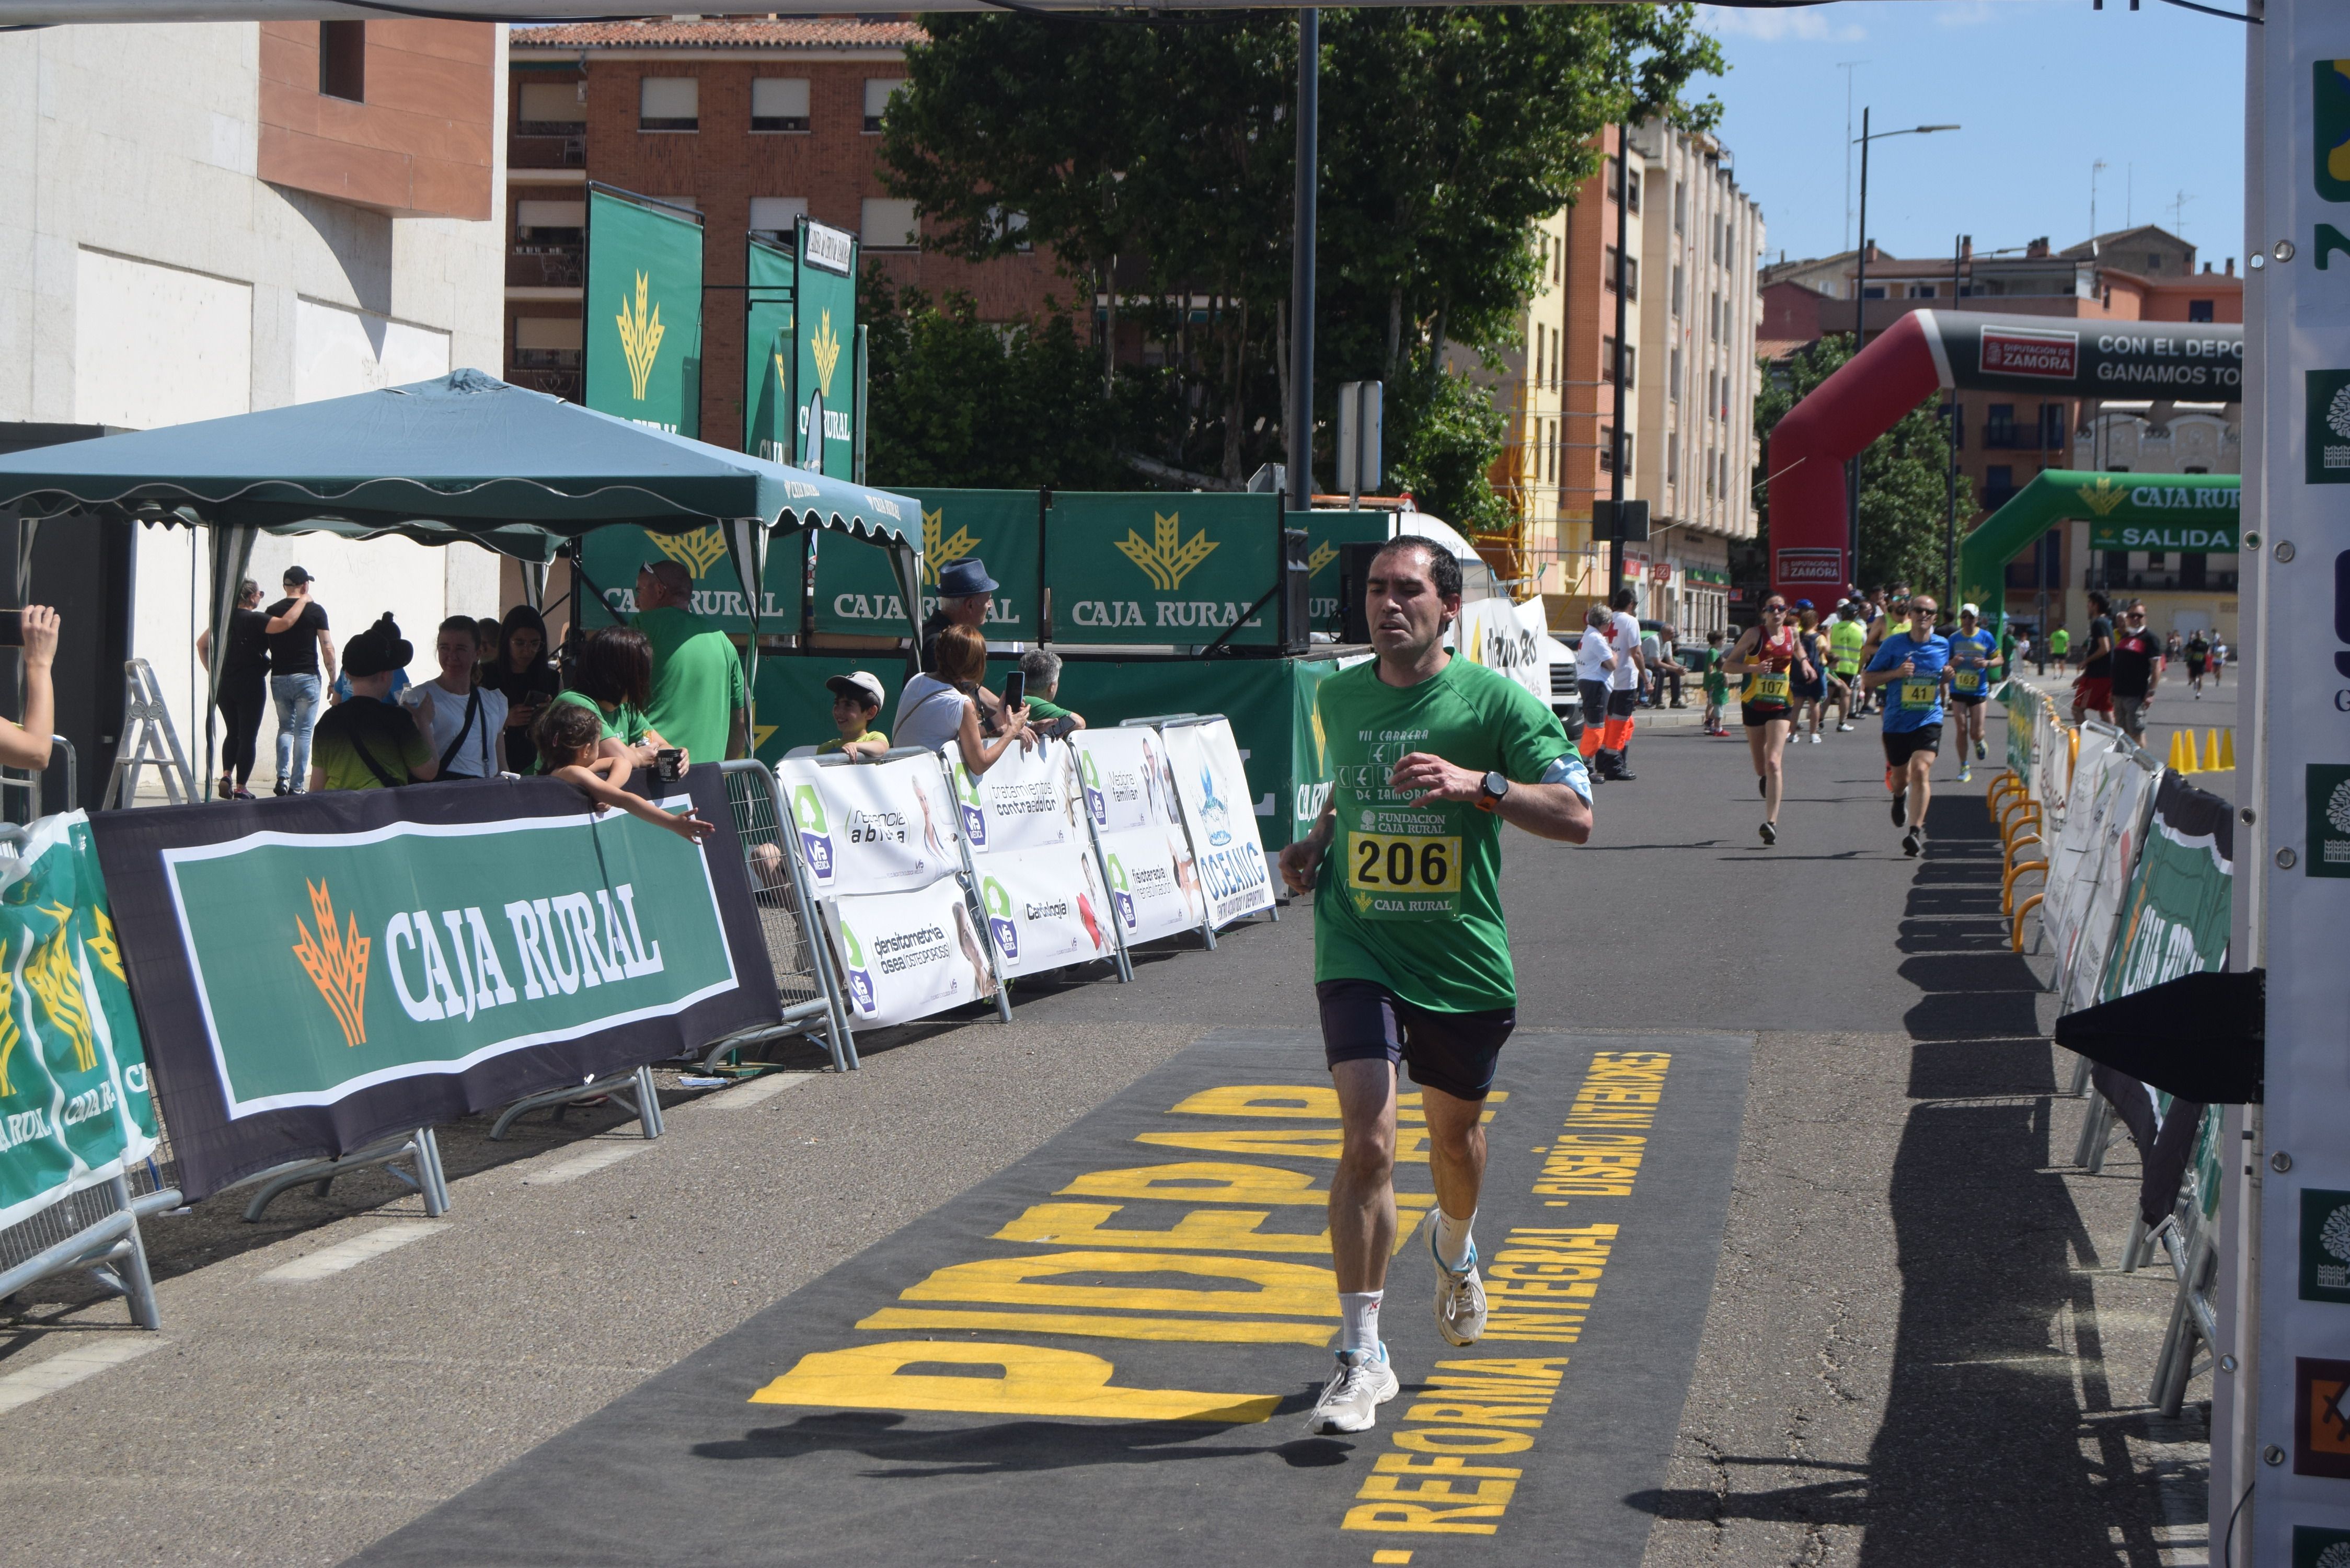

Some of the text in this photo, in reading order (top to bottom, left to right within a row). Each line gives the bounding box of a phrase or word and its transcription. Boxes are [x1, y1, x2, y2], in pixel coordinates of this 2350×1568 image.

[2058, 348, 2071, 356] DE
[2098, 335, 2147, 355] CON
[2153, 338, 2180, 356] EL
[2003, 353, 2070, 371] ZAMORA
[2097, 362, 2243, 386] GANAMOS TO
[2131, 487, 2192, 508] CAJA
[2122, 528, 2230, 547] SALIDA
[1790, 567, 1838, 577] ZAMORA
[835, 594, 907, 620] CAJA
[1073, 601, 1261, 627] CAJA RURAL
[1760, 681, 1783, 694] 107
[1960, 675, 1977, 685] 162
[1911, 687, 1927, 700] 41
[1359, 730, 1429, 741] VII CARRERA
[1109, 771, 1135, 786] Medicina
[992, 780, 1052, 799] tratamientos
[1113, 786, 1139, 802] familiar
[1356, 790, 1370, 800] DE
[996, 800, 1032, 815] contra
[1378, 812, 1446, 824] FUNDACION
[1378, 823, 1445, 834] CAJA RURAL
[1200, 841, 1265, 901] OCEANIC
[1358, 840, 1447, 885] 206
[1132, 864, 1166, 884] fisioterapia
[1026, 898, 1067, 920] Cardiología
[1217, 901, 1228, 922] CENTRO
[1245, 887, 1265, 909] DEPORTIVO
[1374, 900, 1453, 912] CAJA RURAL
[874, 923, 944, 956] densitometría
[385, 883, 664, 1023] CAJA RURAL
[1563, 1052, 1672, 1128] INTERIORES
[1531, 1134, 1646, 1196] DISEÑO
[1479, 1224, 1619, 1343] INTEGRAL
[1341, 1356, 1569, 1535] REFORMA
